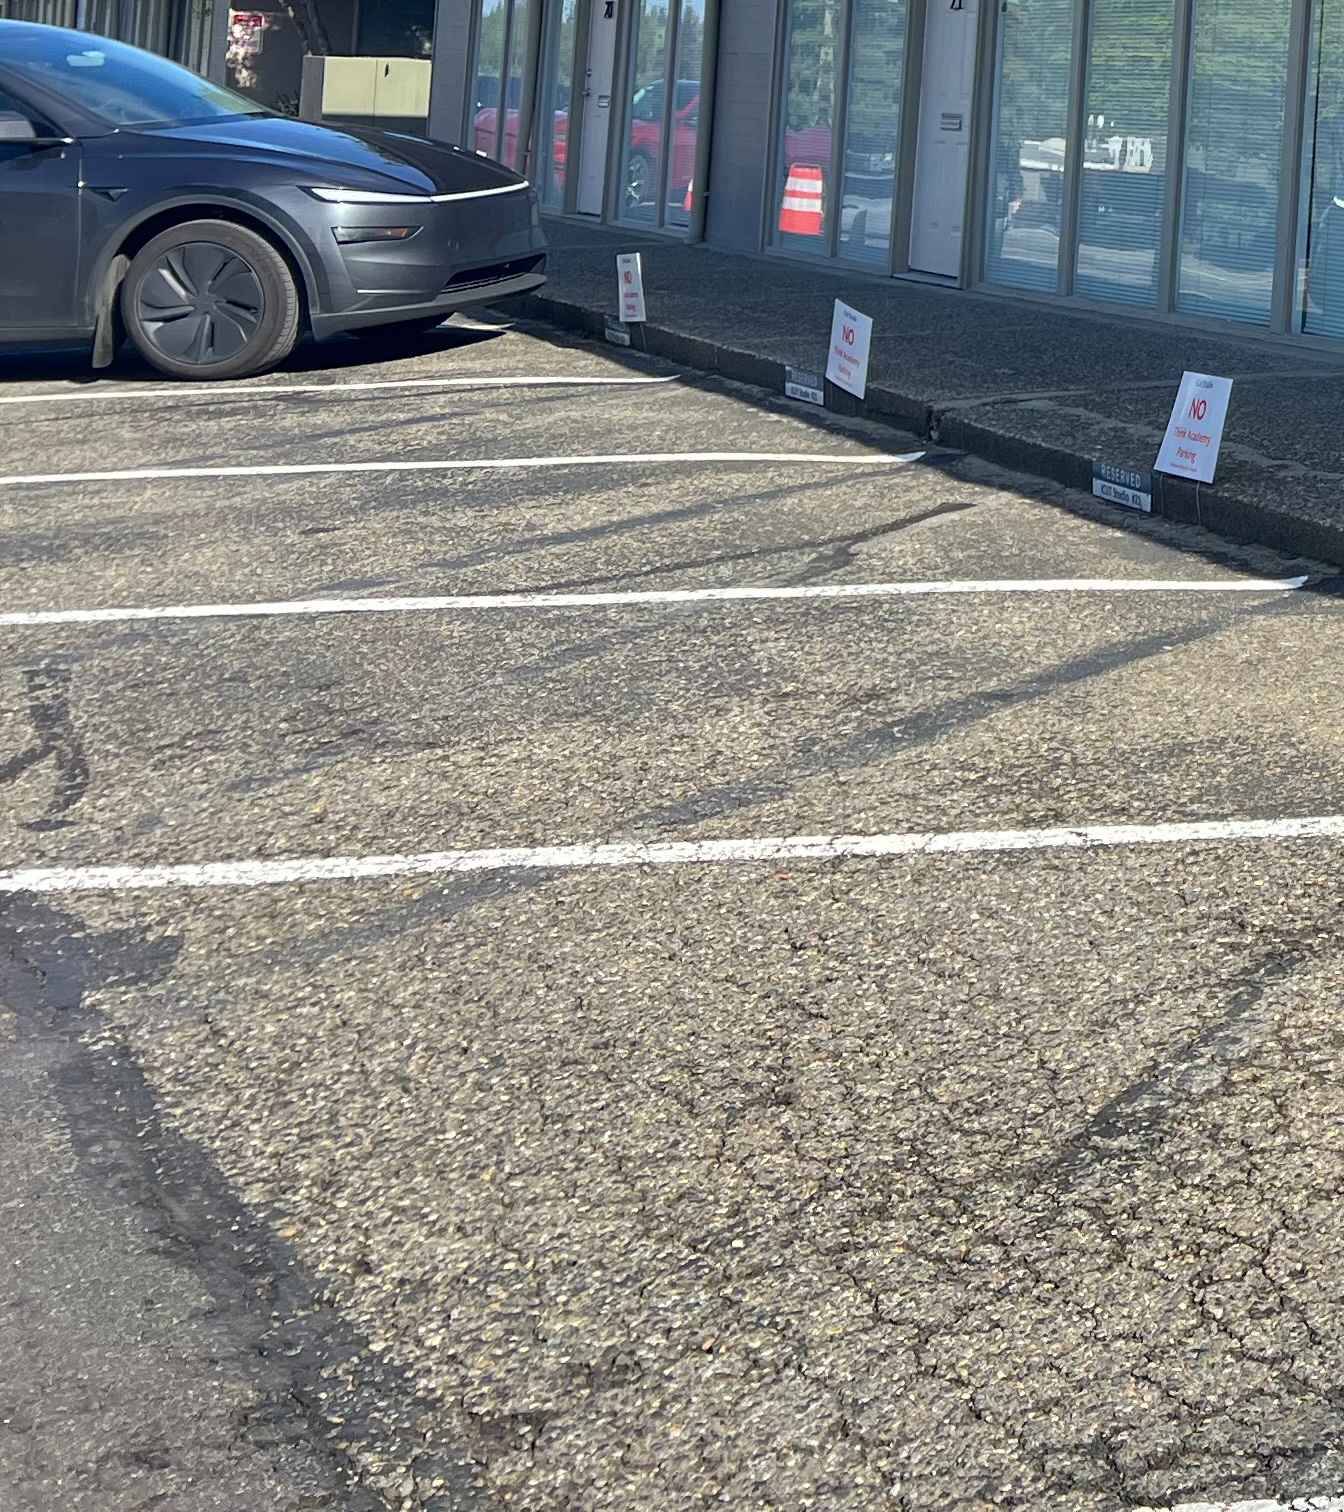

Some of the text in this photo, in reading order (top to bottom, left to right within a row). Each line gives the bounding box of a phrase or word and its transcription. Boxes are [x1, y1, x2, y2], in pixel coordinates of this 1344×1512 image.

[842, 324, 855, 346] NO
[1188, 397, 1208, 421] NO
[1187, 429, 1212, 447] Academy
[1176, 446, 1197, 464] Parking
[1100, 463, 1141, 489] RESERVED
